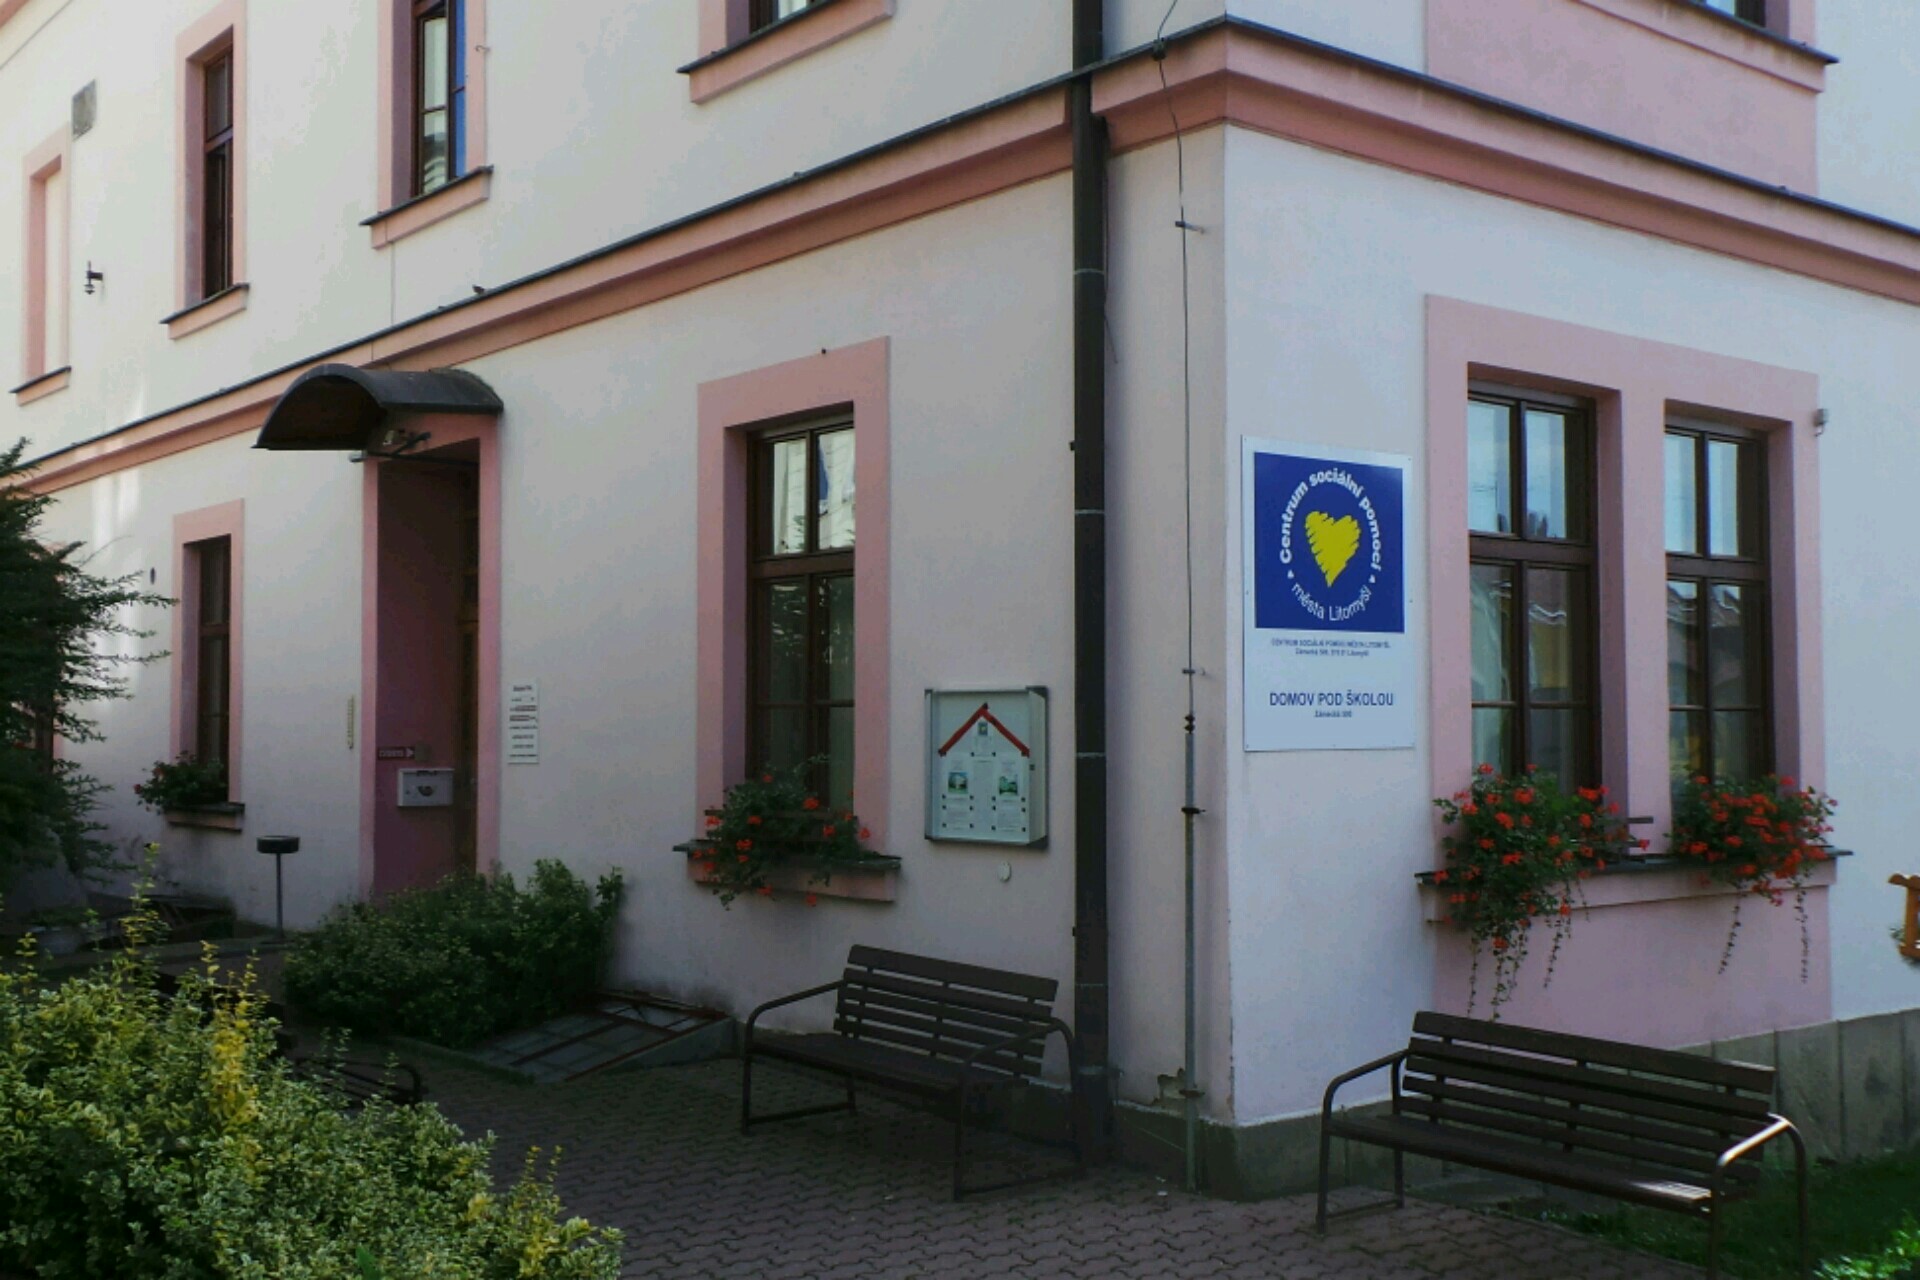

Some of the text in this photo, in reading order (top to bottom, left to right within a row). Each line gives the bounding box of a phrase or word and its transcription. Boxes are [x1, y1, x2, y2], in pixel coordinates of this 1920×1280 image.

[1279, 467, 1382, 572] Centrum sociální pomoci
[1291, 582, 1372, 621] města Litomyšl
[1269, 689, 1394, 707] DOMOV POD ŠKOLOU
